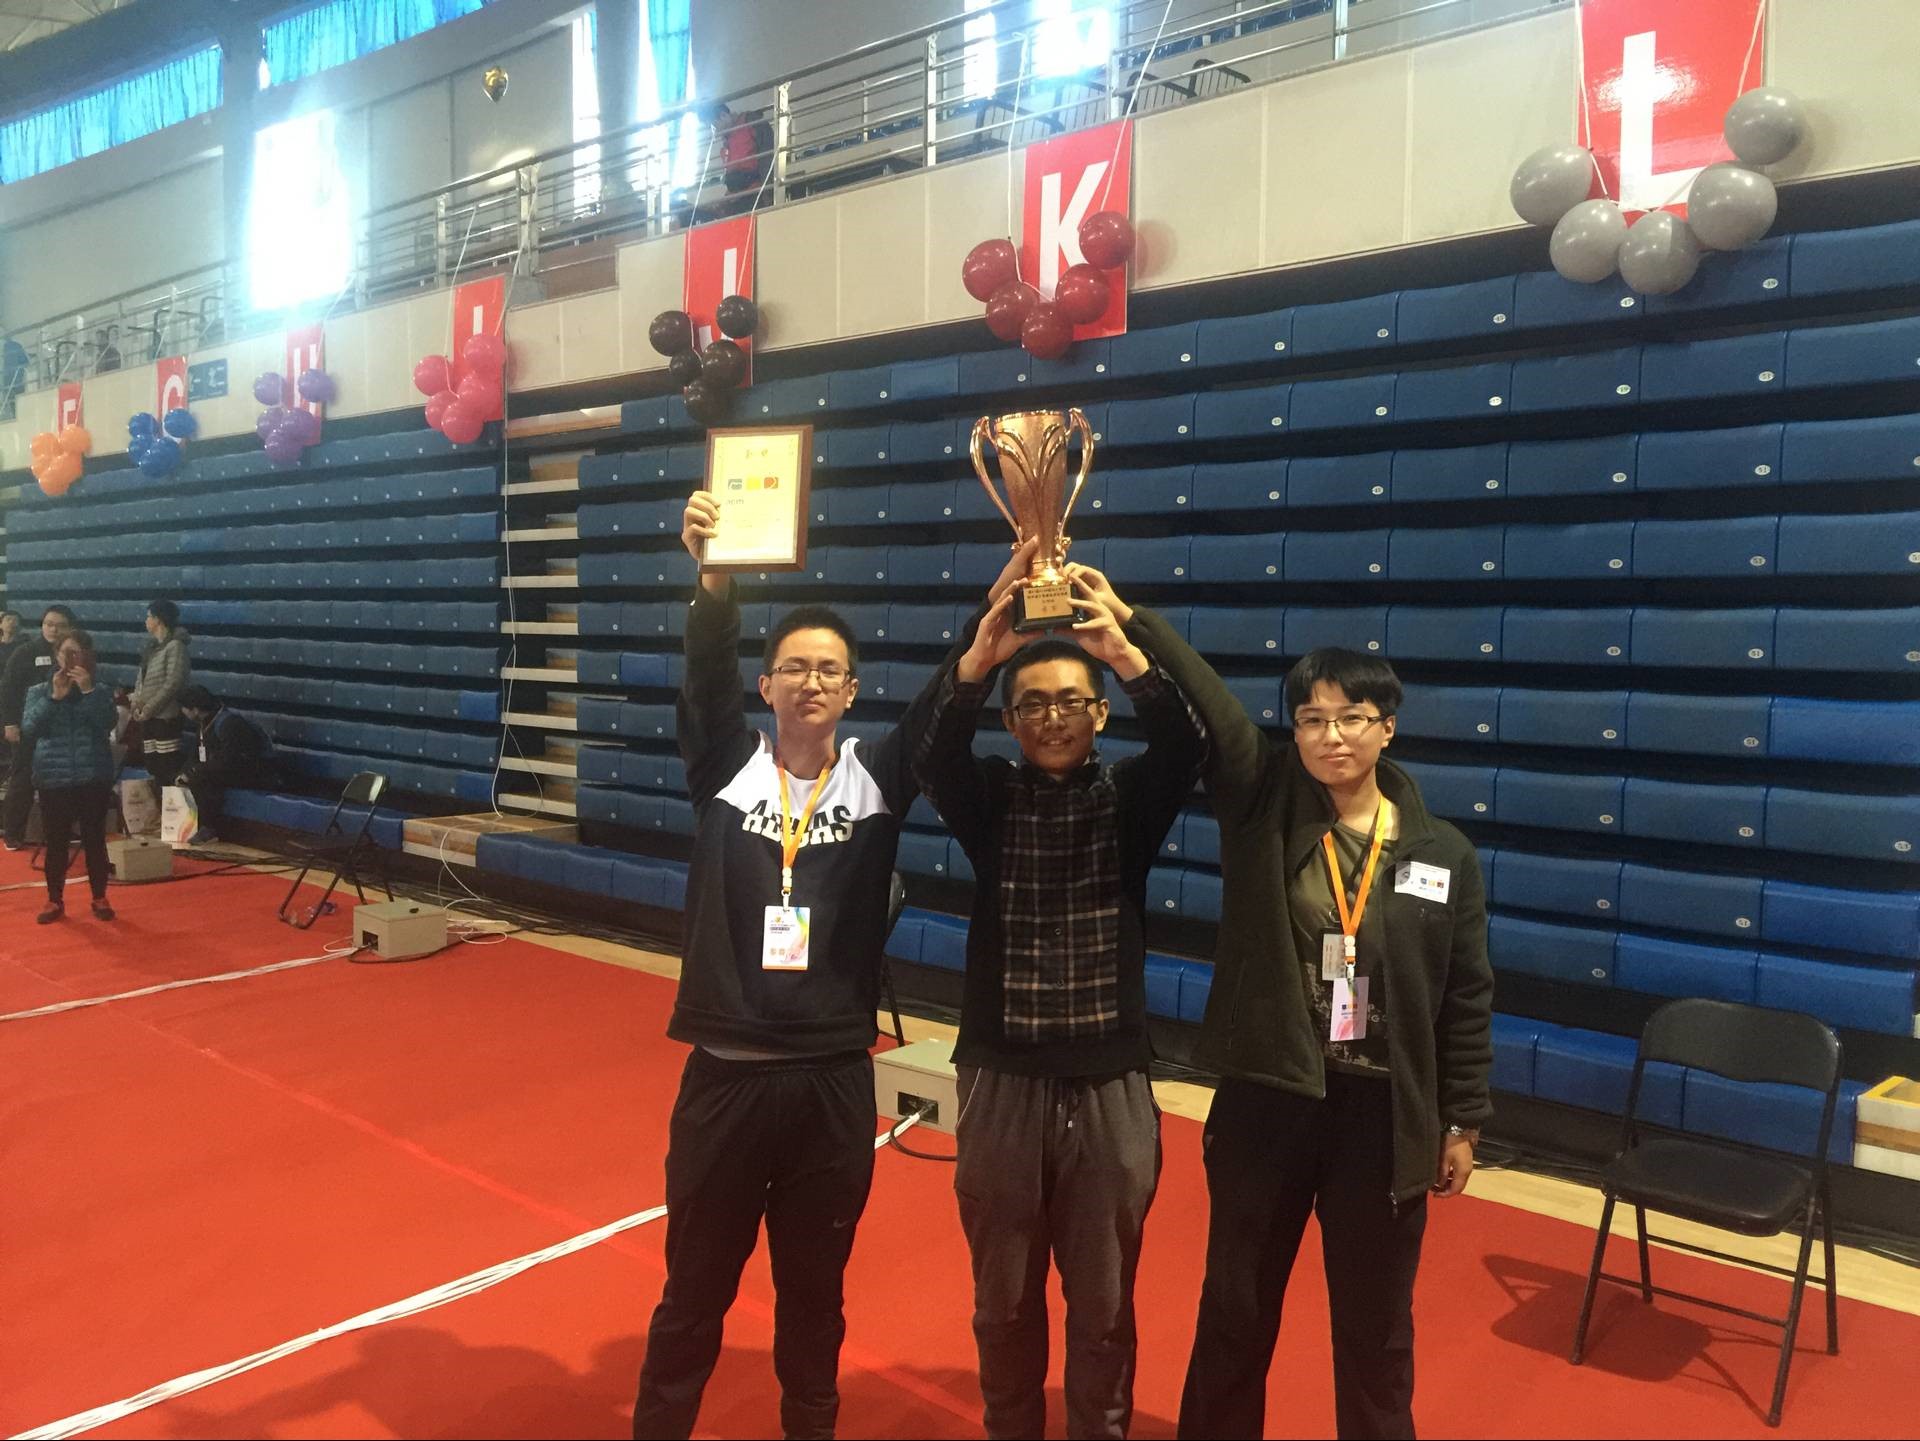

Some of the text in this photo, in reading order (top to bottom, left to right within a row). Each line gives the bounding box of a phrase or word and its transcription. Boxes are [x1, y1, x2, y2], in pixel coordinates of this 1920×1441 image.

[1618, 30, 1706, 210] L
[1039, 160, 1111, 303] K
[742, 799, 853, 849] ADDAS
